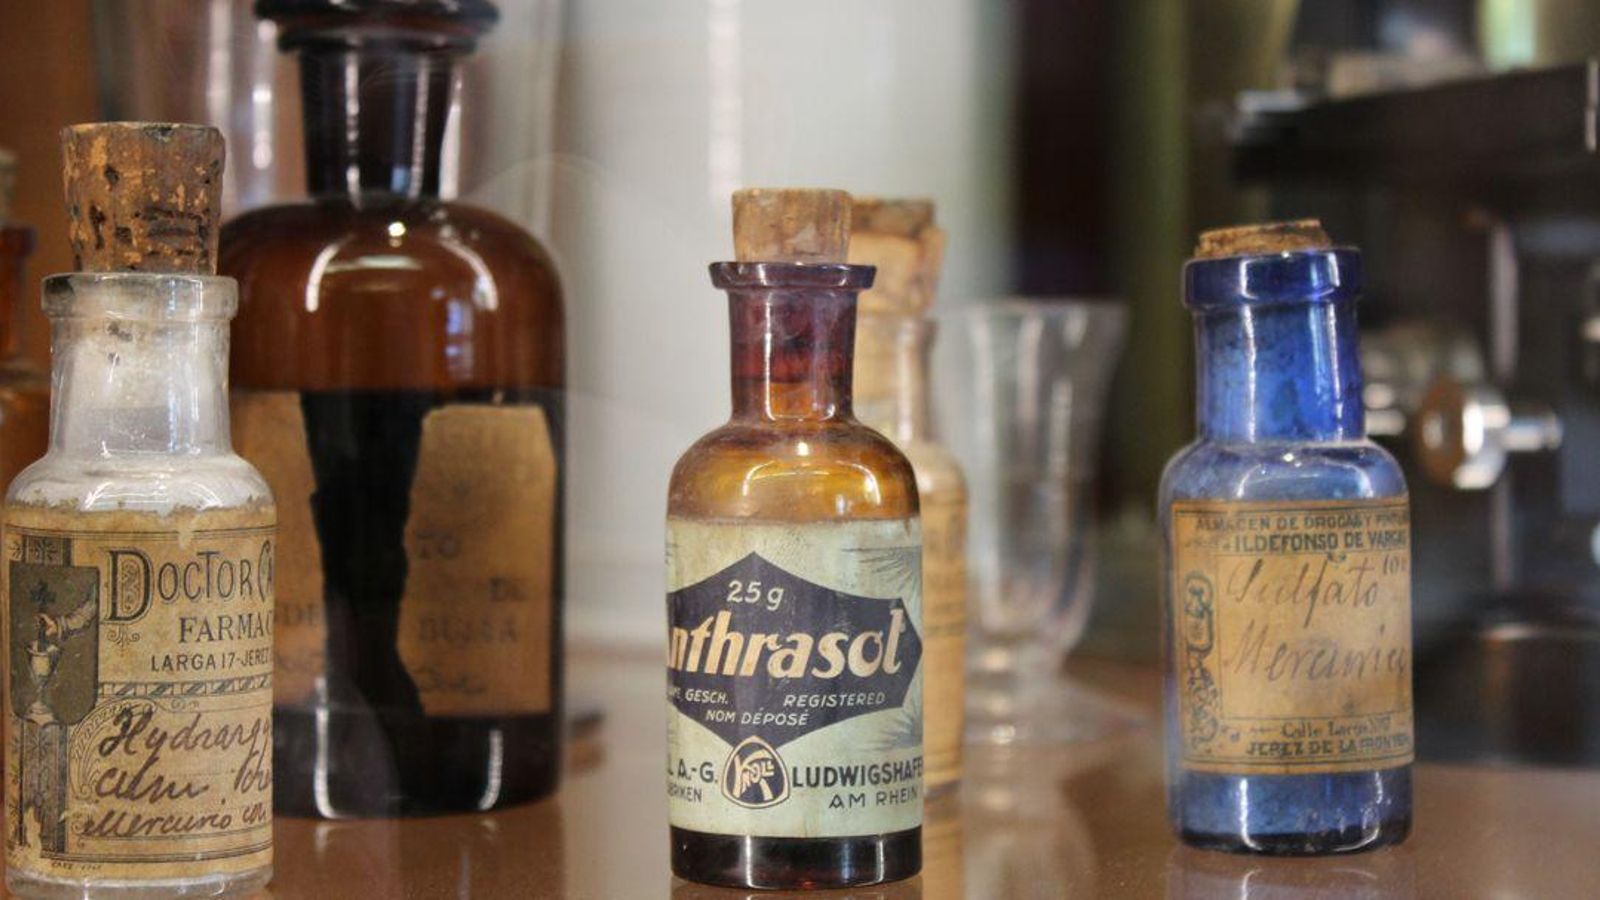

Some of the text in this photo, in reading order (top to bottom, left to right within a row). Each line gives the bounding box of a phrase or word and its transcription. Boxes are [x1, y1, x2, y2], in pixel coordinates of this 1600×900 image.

[1276, 516, 1300, 531] DE
[1234, 531, 1339, 552] ILDEFONSO
[1343, 530, 1365, 549] DE
[726, 580, 785, 611] 25 g
[667, 608, 906, 679] nthrasol
[151, 654, 217, 673] LARGA
[684, 688, 729, 705] GESCH.
[783, 692, 886, 708] REGISTERED
[704, 708, 736, 723] NOM
[1308, 737, 1335, 755] DE
[1339, 735, 1359, 754] LA
[828, 792, 867, 810] AM
[875, 785, 919, 806] RHEIN
